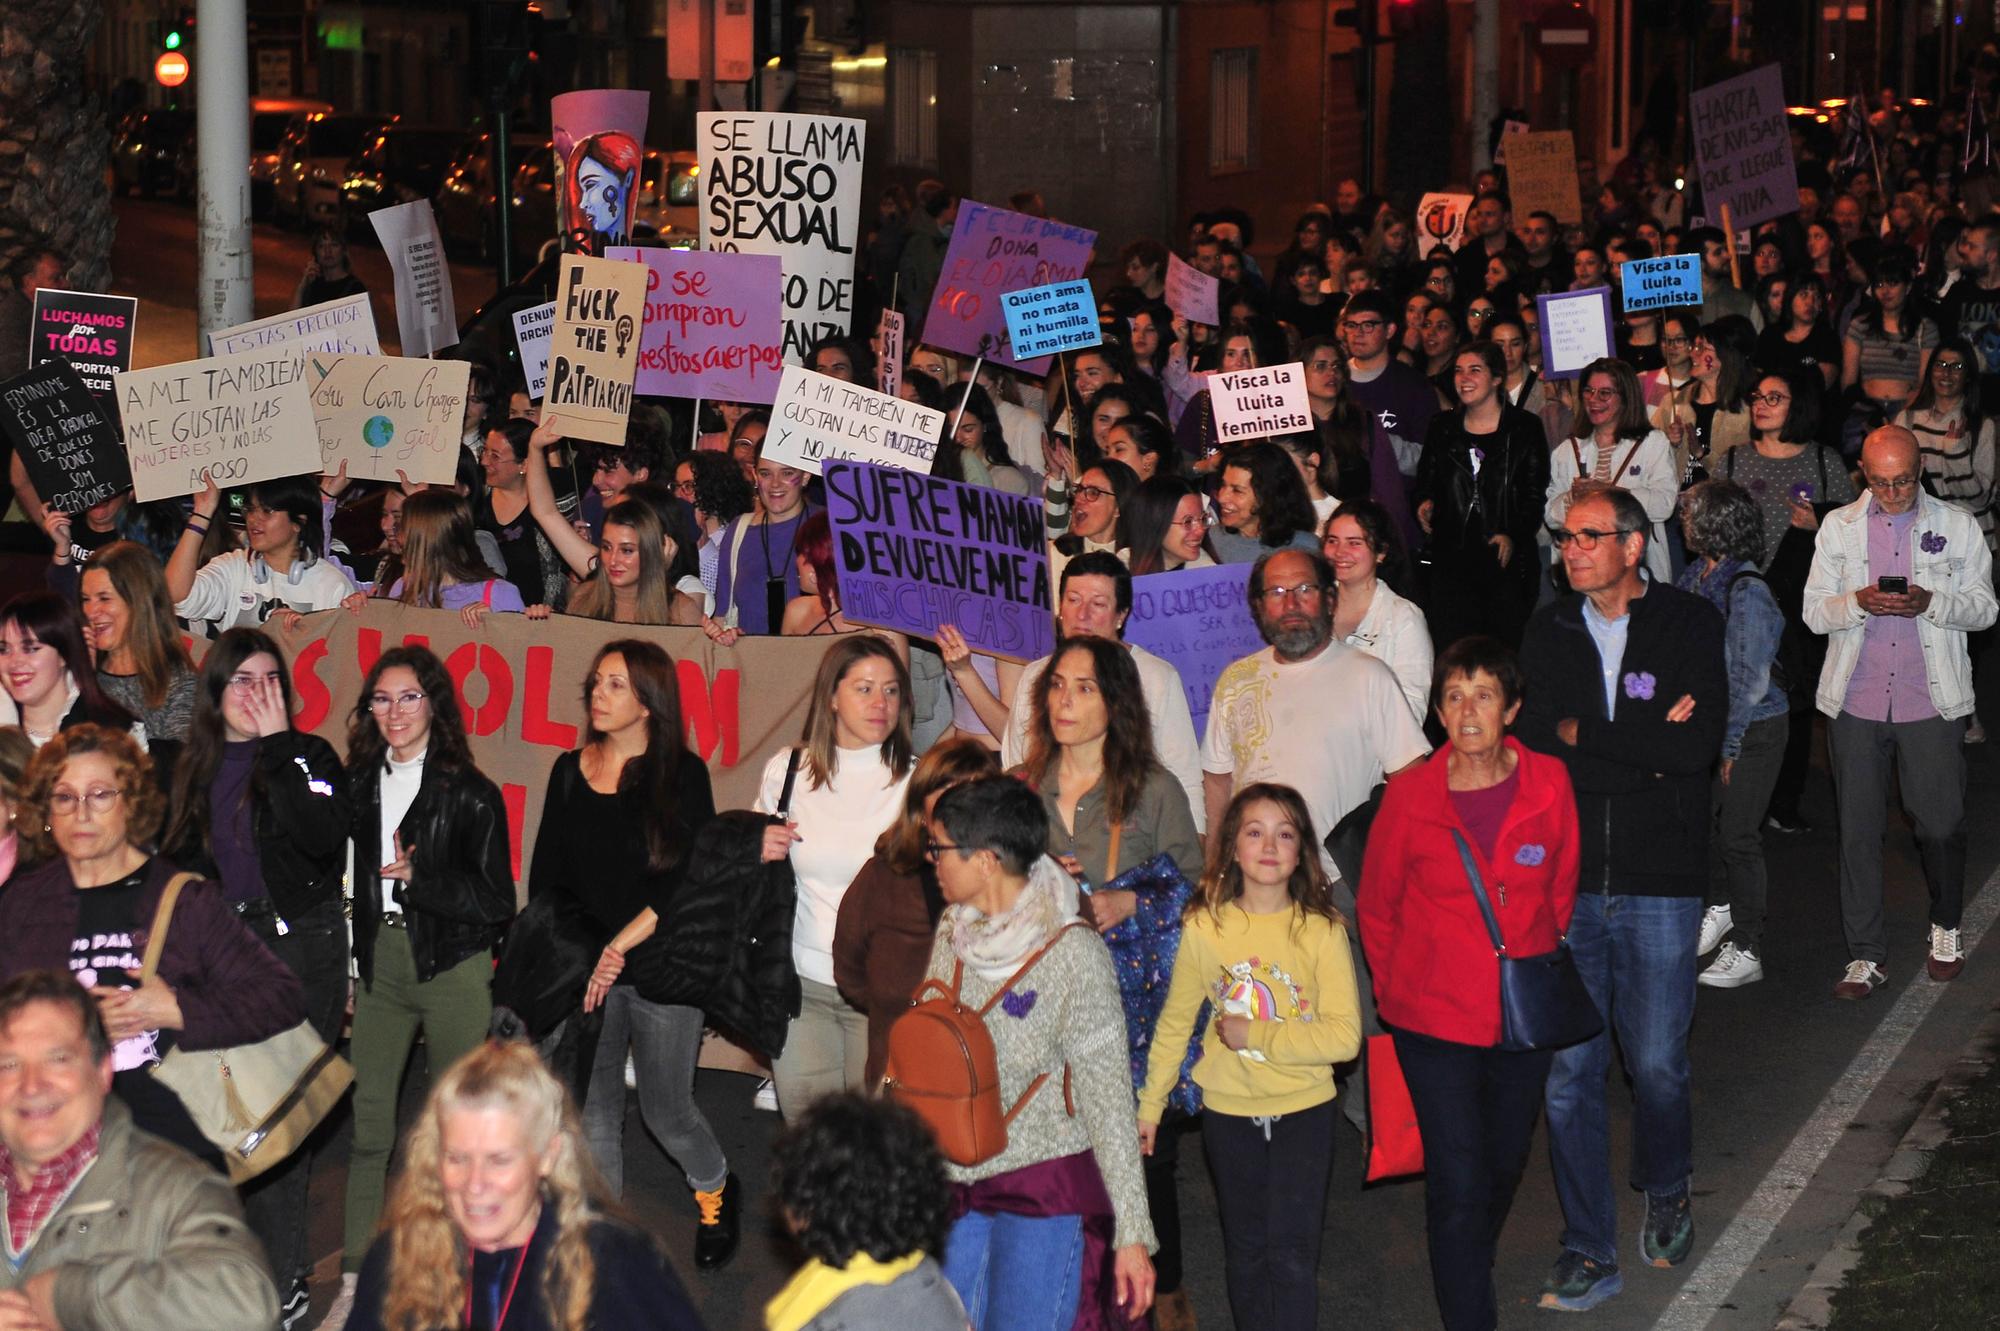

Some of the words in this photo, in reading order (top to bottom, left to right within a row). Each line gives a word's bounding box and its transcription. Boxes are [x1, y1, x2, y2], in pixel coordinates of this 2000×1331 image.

[710, 119, 755, 152] SE
[767, 119, 861, 164] LLAMA
[708, 155, 838, 203] ABUSO
[1730, 186, 1773, 217] VIVA
[710, 194, 853, 254] SEXUAL
[1632, 261, 1671, 275] Visca
[1675, 258, 1690, 271] la
[671, 270, 712, 297] se
[817, 277, 853, 312] DE
[1642, 275, 1682, 290] lluita
[1008, 291, 1051, 309] Quien
[1055, 285, 1085, 299] ama
[1627, 290, 1699, 309] feminista
[42, 308, 126, 330] LUCHAMOS
[520, 307, 556, 326] DENUN
[644, 302, 746, 339] ompran
[1021, 308, 1040, 321] no
[1043, 301, 1080, 317] mata
[68, 323, 97, 339] por
[520, 325, 554, 343] ARCHI
[1019, 325, 1033, 339] ni
[1036, 314, 1090, 333] humilla
[46, 332, 119, 358] TODAS
[228, 327, 287, 355] ESTAS
[1018, 340, 1032, 354] ni
[1035, 329, 1096, 349] maltrata
[70, 362, 120, 377] PORTAR
[703, 343, 780, 380] cuerpos
[126, 384, 145, 414] A
[149, 377, 192, 408] MI
[203, 348, 305, 402] TAMBIÉN
[311, 358, 344, 407] You
[363, 364, 407, 409] Can
[414, 366, 460, 423] Change
[1221, 374, 1270, 392] Visca
[1274, 369, 1291, 385] la
[46, 399, 70, 418] LA
[795, 378, 807, 397] A
[815, 383, 834, 402] MI
[841, 388, 905, 424] TAMBIÉN
[911, 411, 938, 434] ME
[1236, 393, 1285, 411] lluita
[26, 424, 57, 449] IDEA
[59, 411, 102, 437] RADICAL
[128, 415, 163, 448] ME
[172, 404, 247, 444] GUSTAN
[250, 396, 282, 431] LAS
[784, 400, 845, 434] GUSTAN
[848, 422, 880, 446] LAS
[884, 430, 938, 462] MUJERES
[1222, 413, 1308, 437] feminista
[38, 447, 56, 463] DE
[134, 443, 212, 475] MUJERES
[219, 436, 226, 452] Y
[233, 432, 250, 449] NO
[251, 426, 273, 447] LAS
[777, 428, 793, 447] Y
[804, 437, 825, 459] NO
[57, 449, 95, 471] DONES
[68, 470, 97, 490] SOM
[52, 481, 117, 516] PERSONES
[826, 463, 954, 538] SUFRE
[844, 578, 893, 621] MIS
[1033, 562, 1051, 611] A
